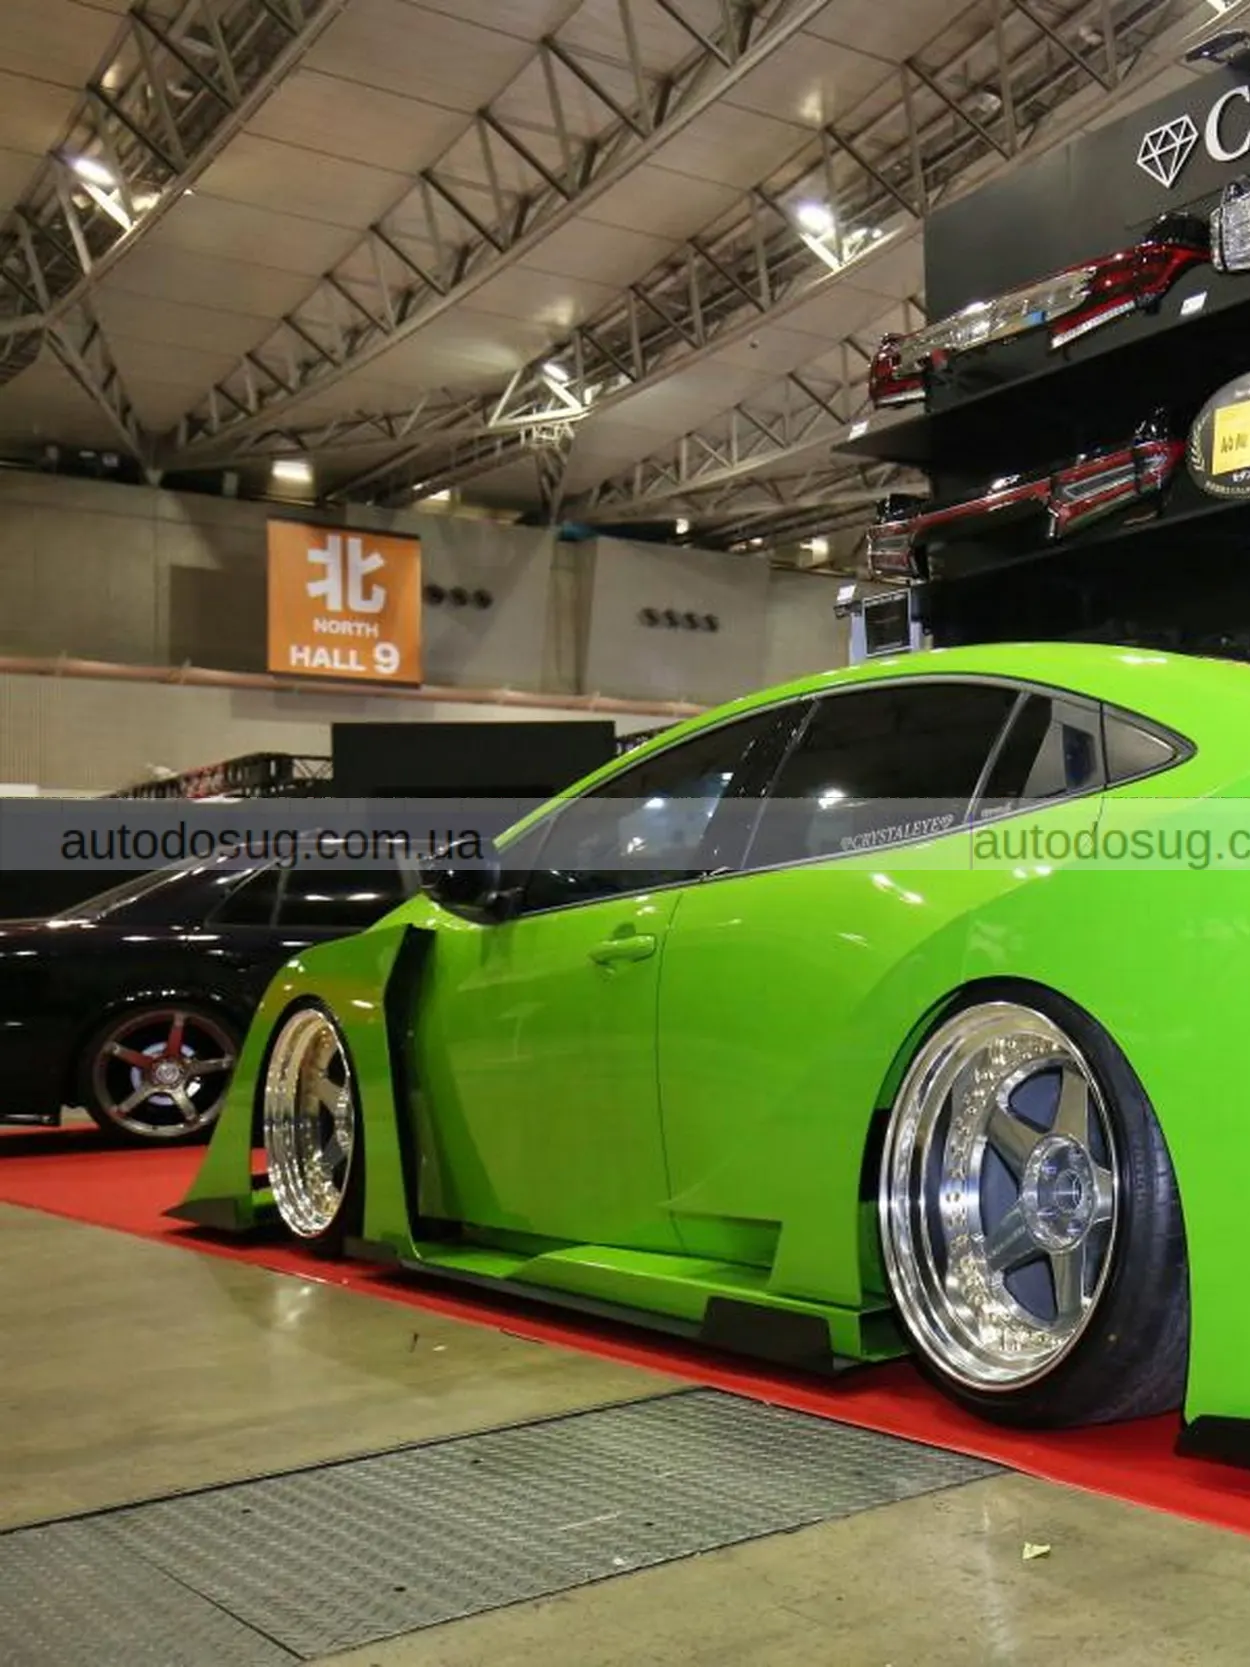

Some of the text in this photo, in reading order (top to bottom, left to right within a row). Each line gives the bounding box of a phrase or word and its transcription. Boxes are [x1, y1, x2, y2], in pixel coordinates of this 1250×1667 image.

[306, 534, 387, 613] 北
[313, 617, 379, 638] NORTH
[290, 641, 400, 675] HALL 9
